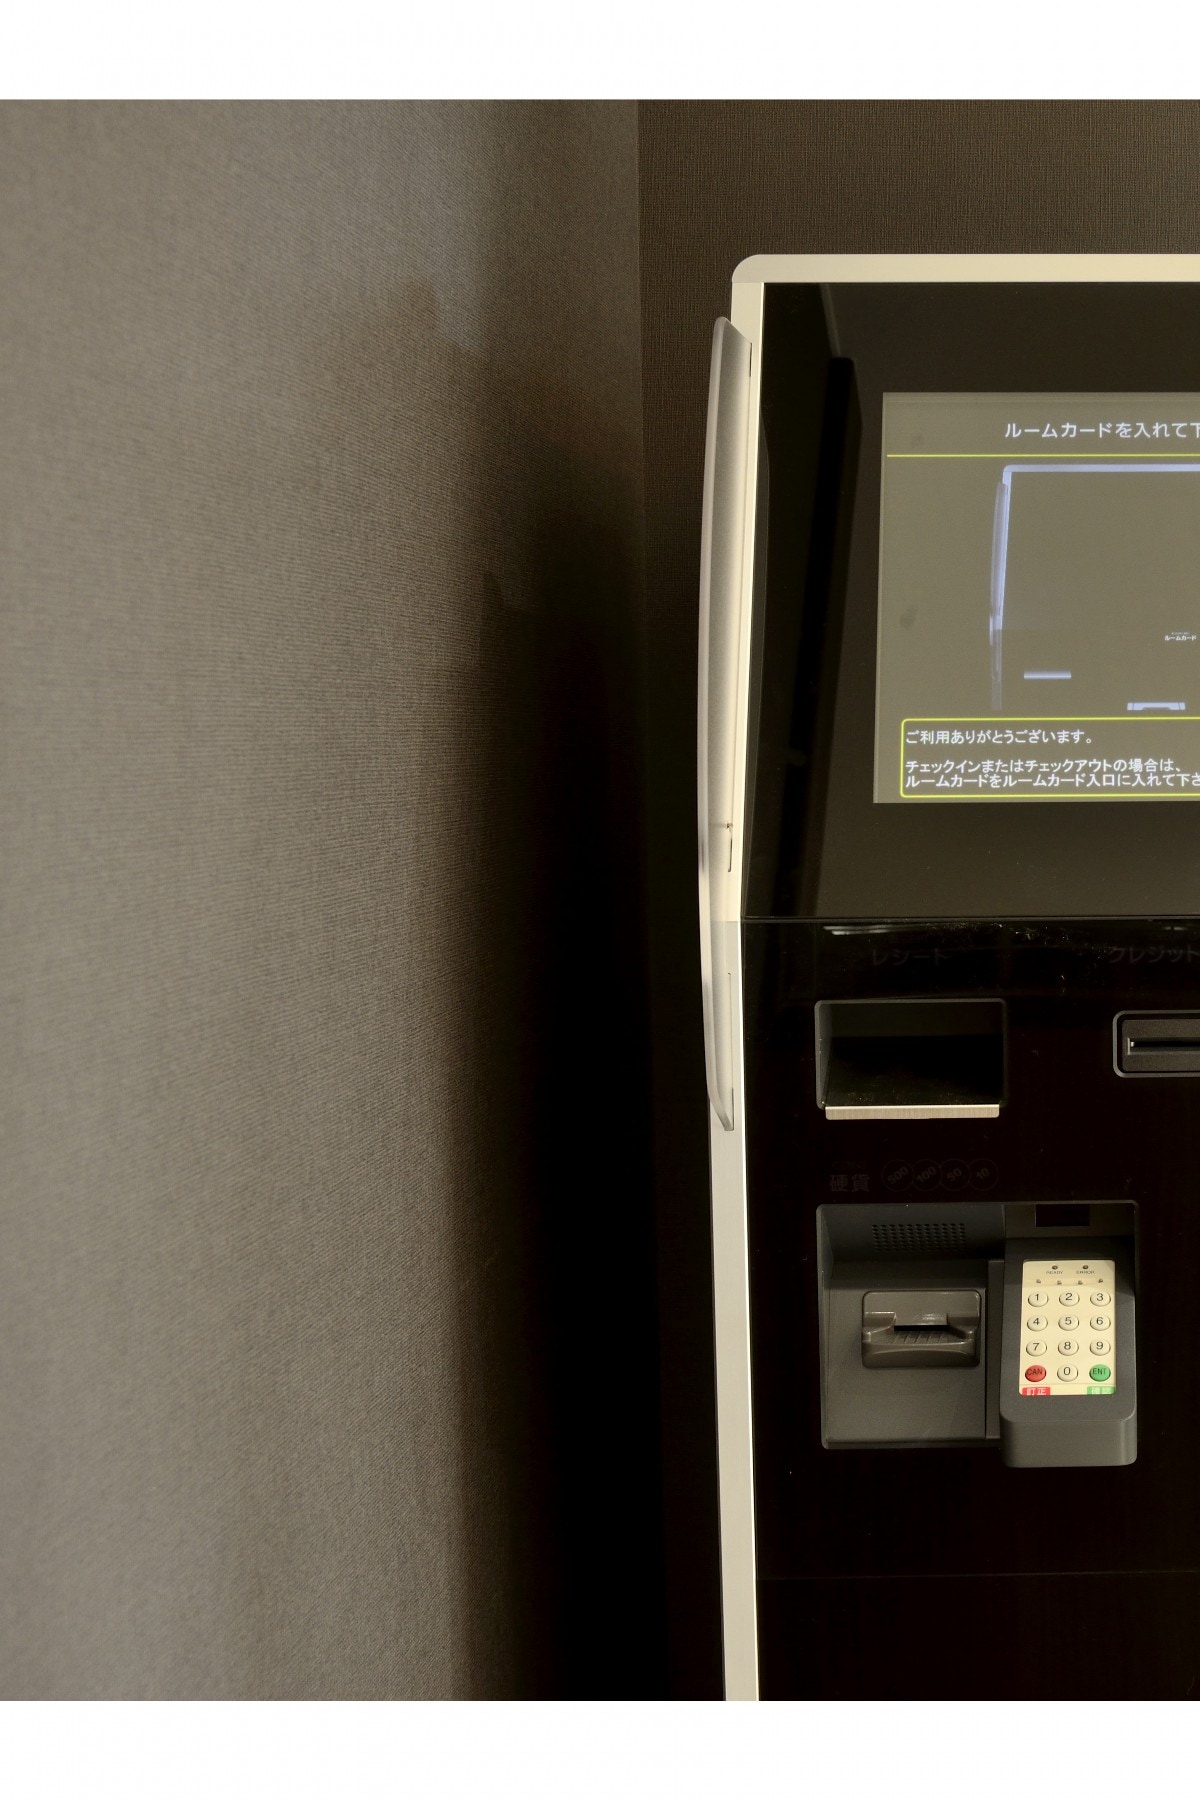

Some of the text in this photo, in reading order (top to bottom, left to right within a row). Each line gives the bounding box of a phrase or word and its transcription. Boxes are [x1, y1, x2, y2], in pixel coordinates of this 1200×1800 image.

[905, 729, 1094, 745] ご利用ありがとうございます。
[905, 758, 1183, 773] チェックインまたはチェックアウトの場合は、
[872, 948, 948, 966] レシート
[886, 1166, 991, 1184] 500 100 50 10
[829, 1174, 871, 1192] 硬貨
[1065, 1293, 1073, 1301] 2
[1096, 1293, 1104, 1301] 3
[1033, 1317, 1104, 1326] 4 5 6
[1032, 1342, 1104, 1351] 7 8 9
[1026, 1368, 1043, 1376] CAN
[1063, 1367, 1071, 1376] 0
